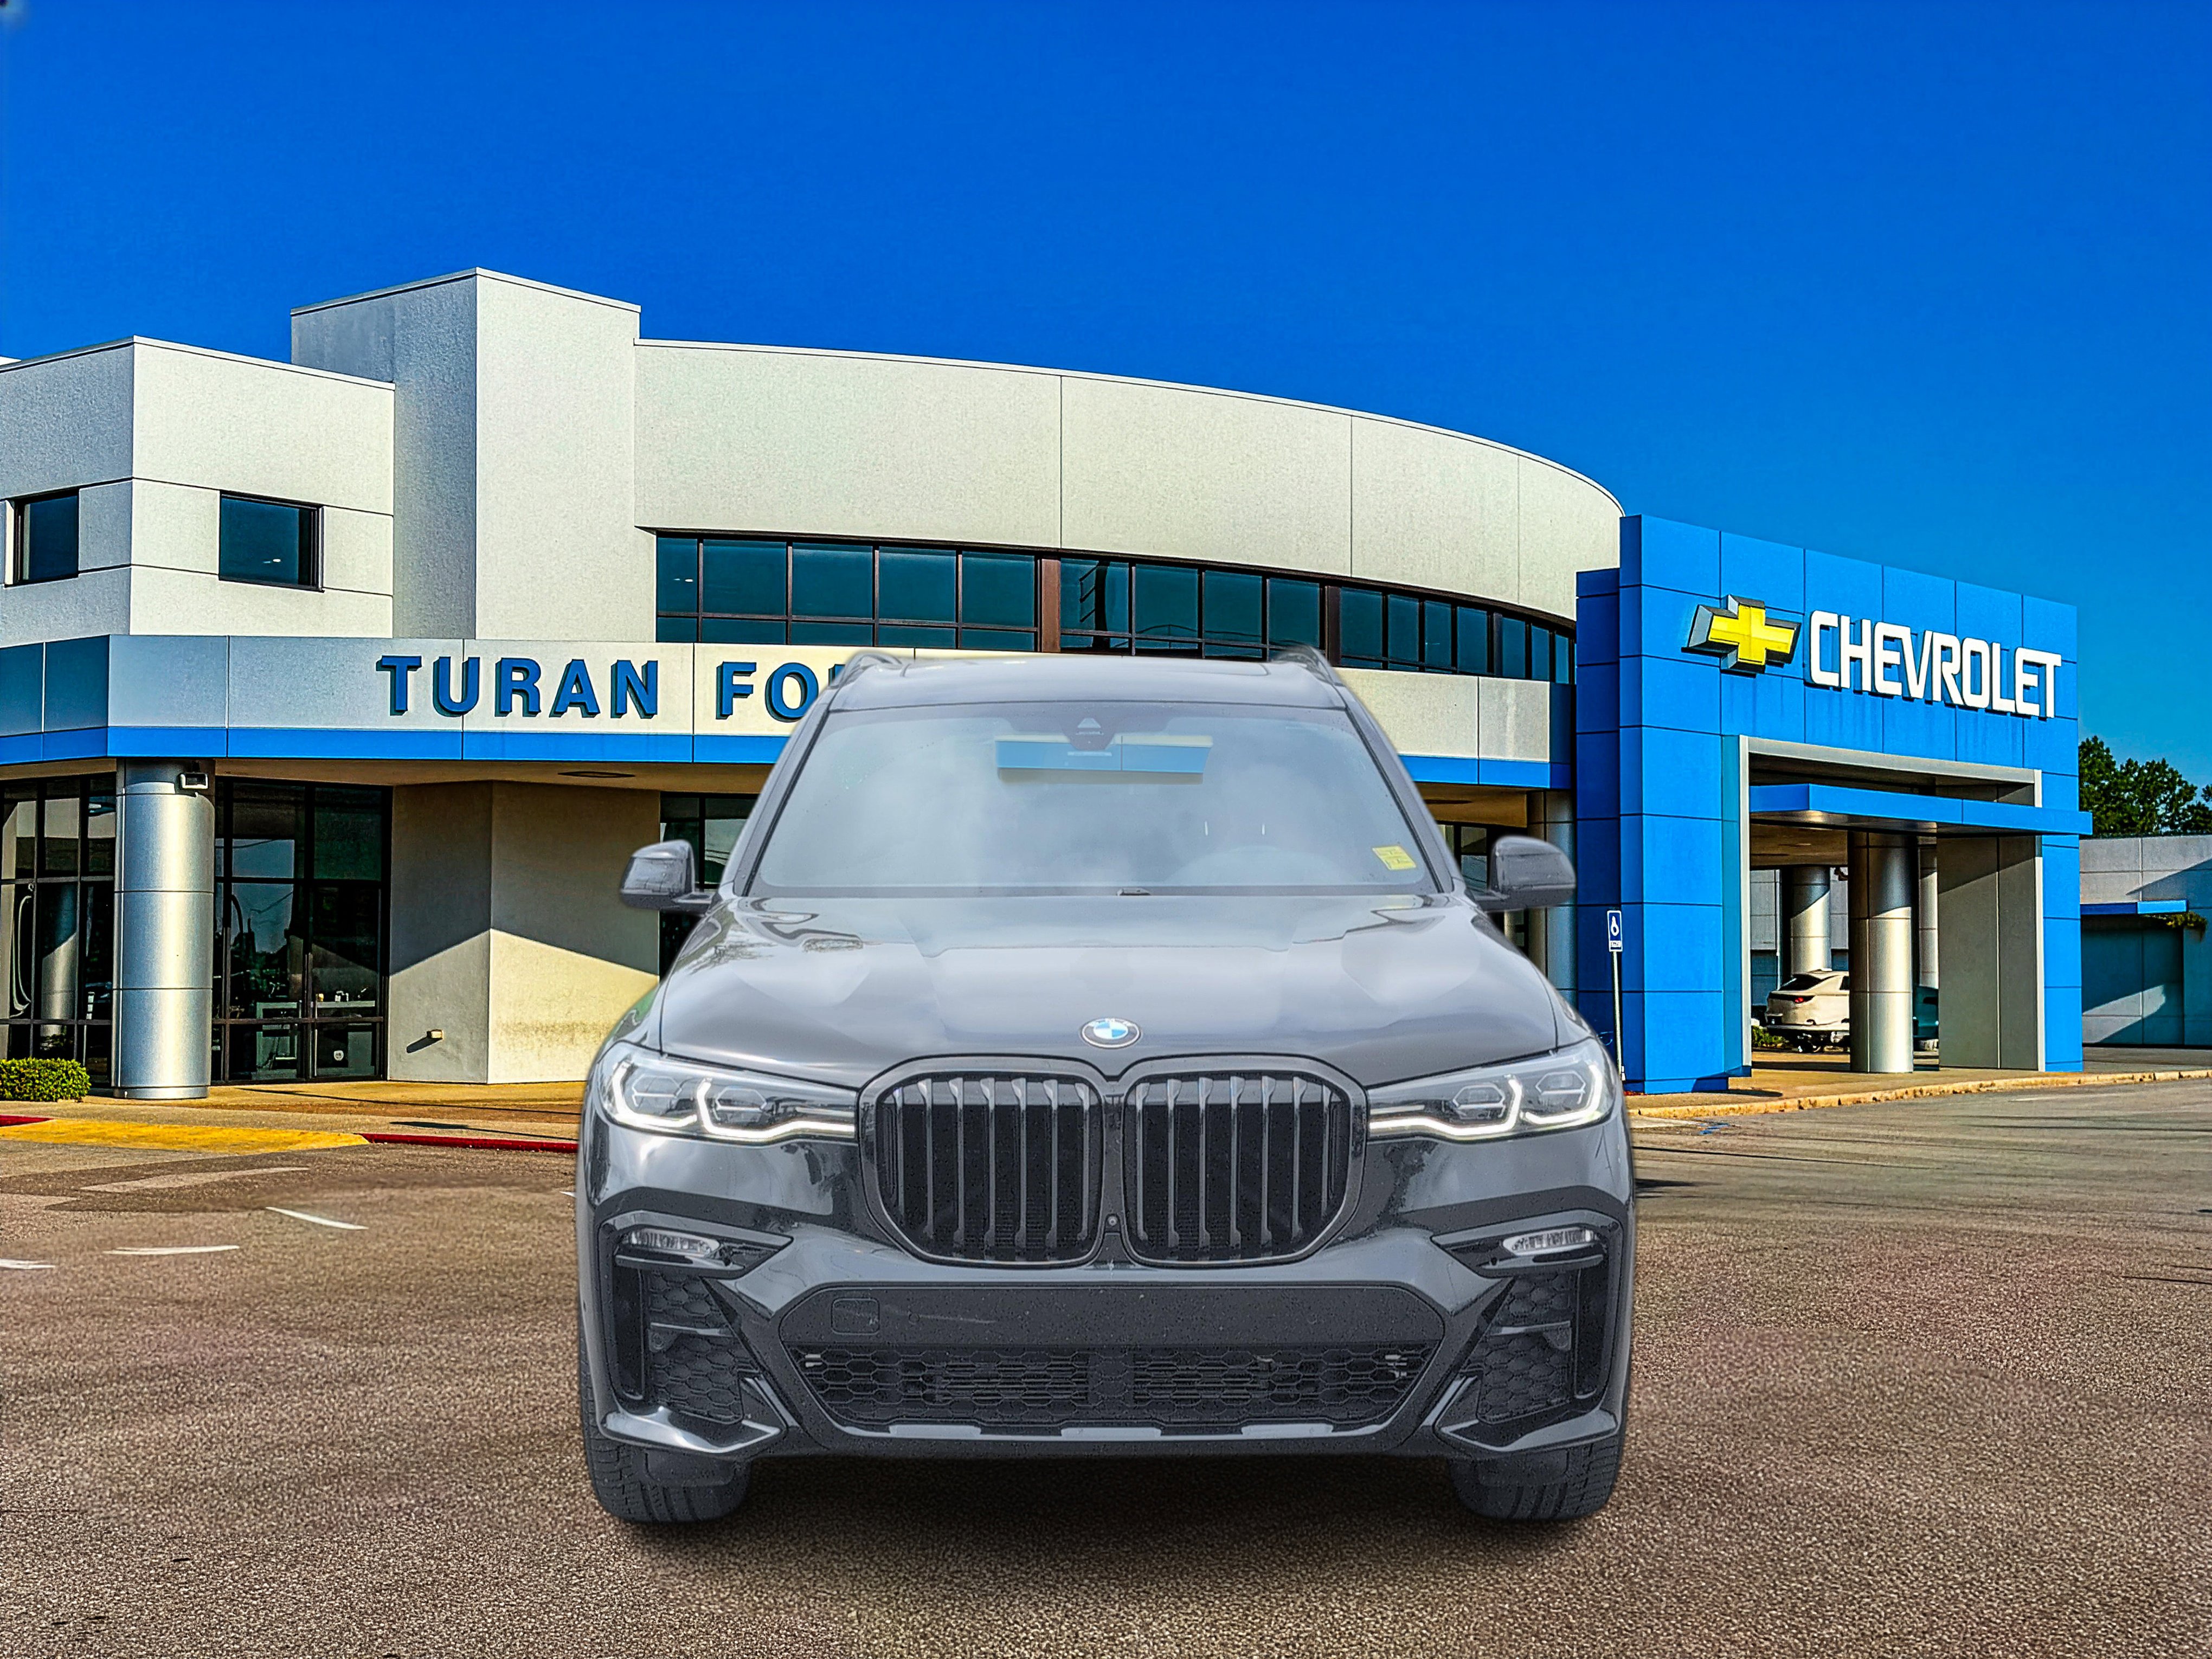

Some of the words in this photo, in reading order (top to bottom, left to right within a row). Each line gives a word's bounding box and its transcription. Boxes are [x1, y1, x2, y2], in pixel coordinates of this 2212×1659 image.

[376, 655, 658, 719] TURAN
[715, 661, 845, 724] FO
[1809, 609, 2062, 719] CHEVROLET
